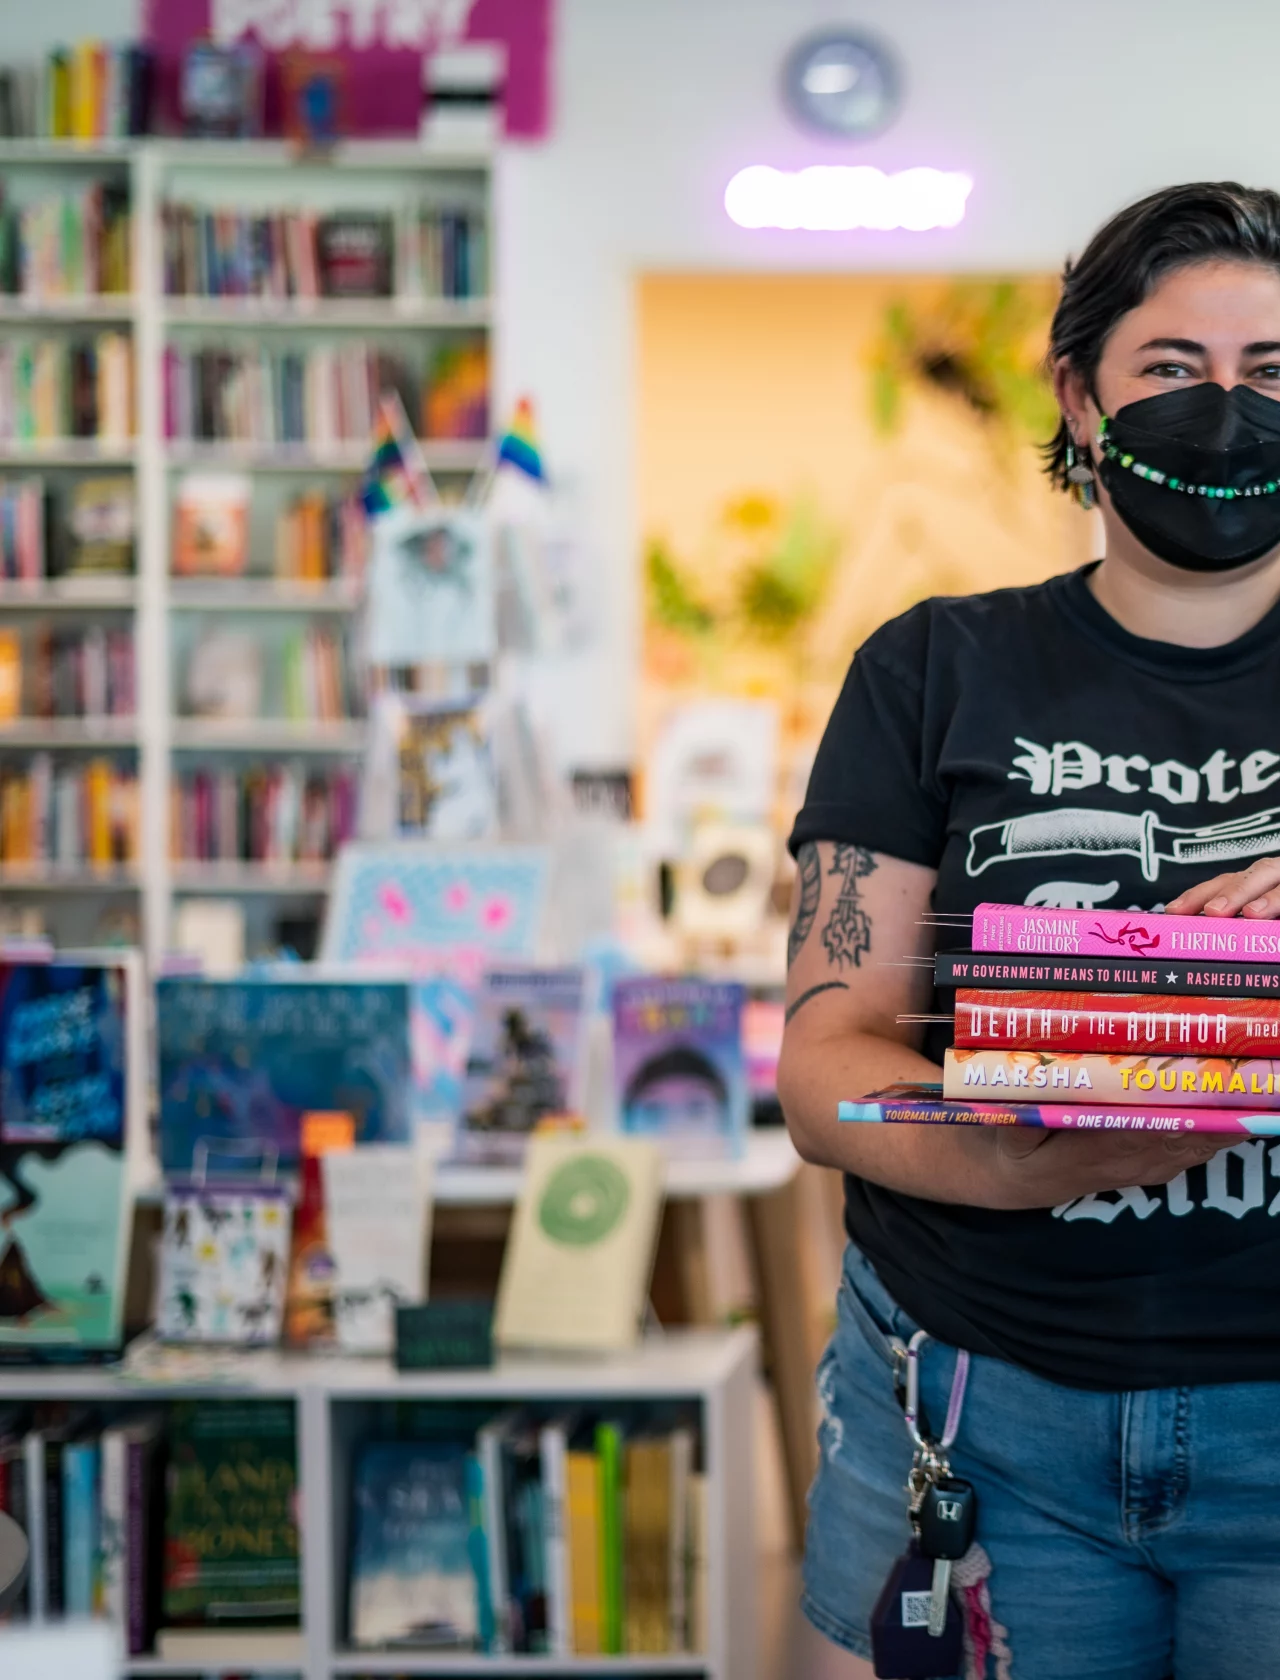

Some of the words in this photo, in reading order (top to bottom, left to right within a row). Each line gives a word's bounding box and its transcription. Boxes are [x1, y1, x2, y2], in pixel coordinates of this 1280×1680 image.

[1021, 918, 1080, 936] JASMINE
[1018, 935, 1082, 953] GUILLORY
[1171, 931, 1237, 952] FLIRTING
[952, 964, 968, 977] MY
[972, 965, 1050, 980] GOVERNMENT
[1054, 968, 1094, 981] MEANS
[1097, 969, 1110, 982] TO
[1114, 969, 1138, 983] KILL
[1142, 971, 1158, 984] ME
[1187, 972, 1241, 987] RASHEED
[971, 1007, 1050, 1039] DEATH
[1061, 1015, 1079, 1034] OF
[1089, 1016, 1115, 1035] THE
[1127, 1012, 1227, 1044] AUTHOR
[964, 1063, 1093, 1090] MARSHA
[885, 1109, 947, 1123] TOURMALINE
[955, 1111, 1017, 1125] KRISTENSEN
[1077, 1114, 1102, 1127] ONE
[1104, 1115, 1130, 1128] DAY
[1132, 1116, 1145, 1129] IN
[1147, 1117, 1181, 1130] JUNE
